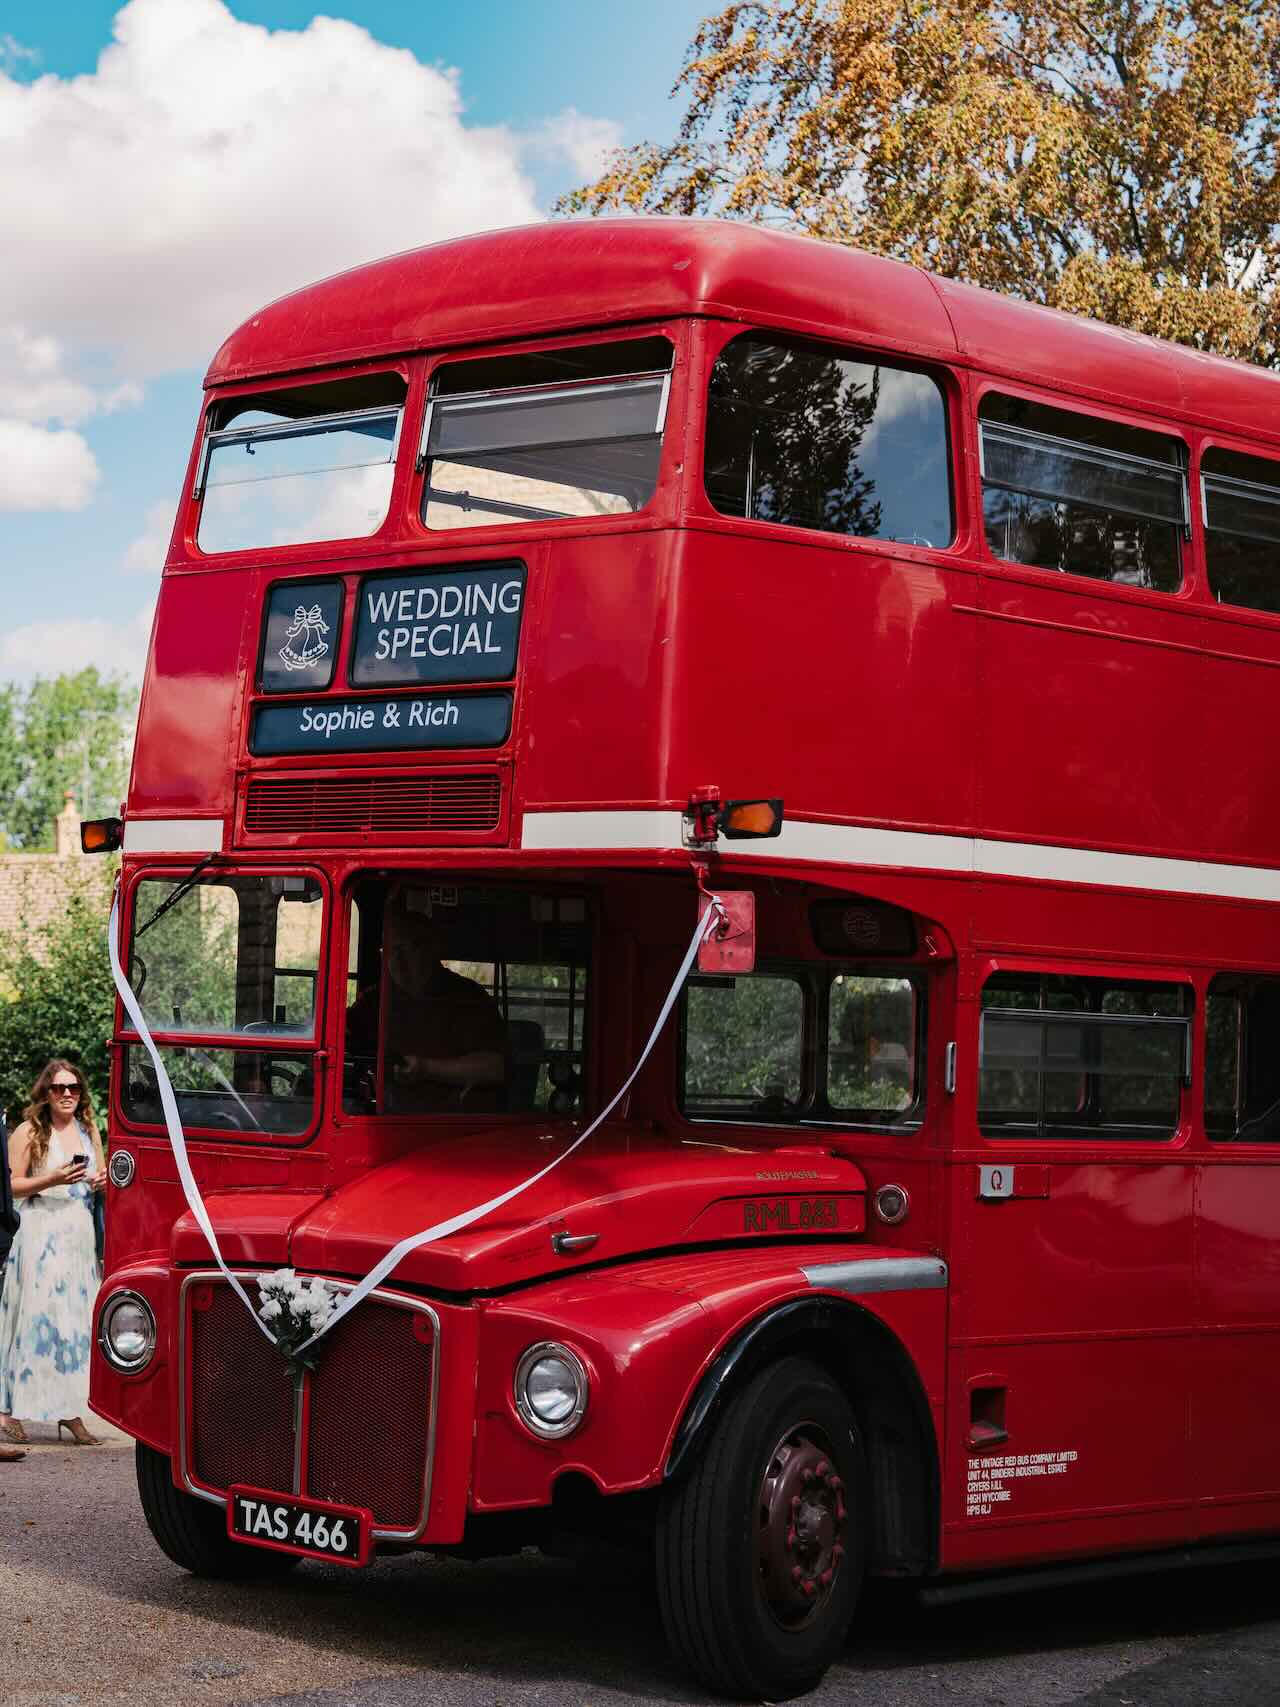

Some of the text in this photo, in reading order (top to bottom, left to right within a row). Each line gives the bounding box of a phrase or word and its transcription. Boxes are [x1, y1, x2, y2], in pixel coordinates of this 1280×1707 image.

[368, 581, 522, 623] WEDDING
[375, 621, 501, 660] SPECIAL
[300, 700, 458, 738] Sophie & Rich
[968, 1458, 980, 1469] THE
[981, 1457, 1004, 1468] VINTAGE
[1005, 1456, 1016, 1467] RED
[1017, 1455, 1029, 1466] BUS
[1030, 1453, 1056, 1464] COMPANY
[968, 1470, 981, 1481] UNIT
[1048, 1463, 1067, 1474] ESTATE
[967, 1493, 981, 1504] HIGH
[240, 1500, 348, 1551] TAS 466
